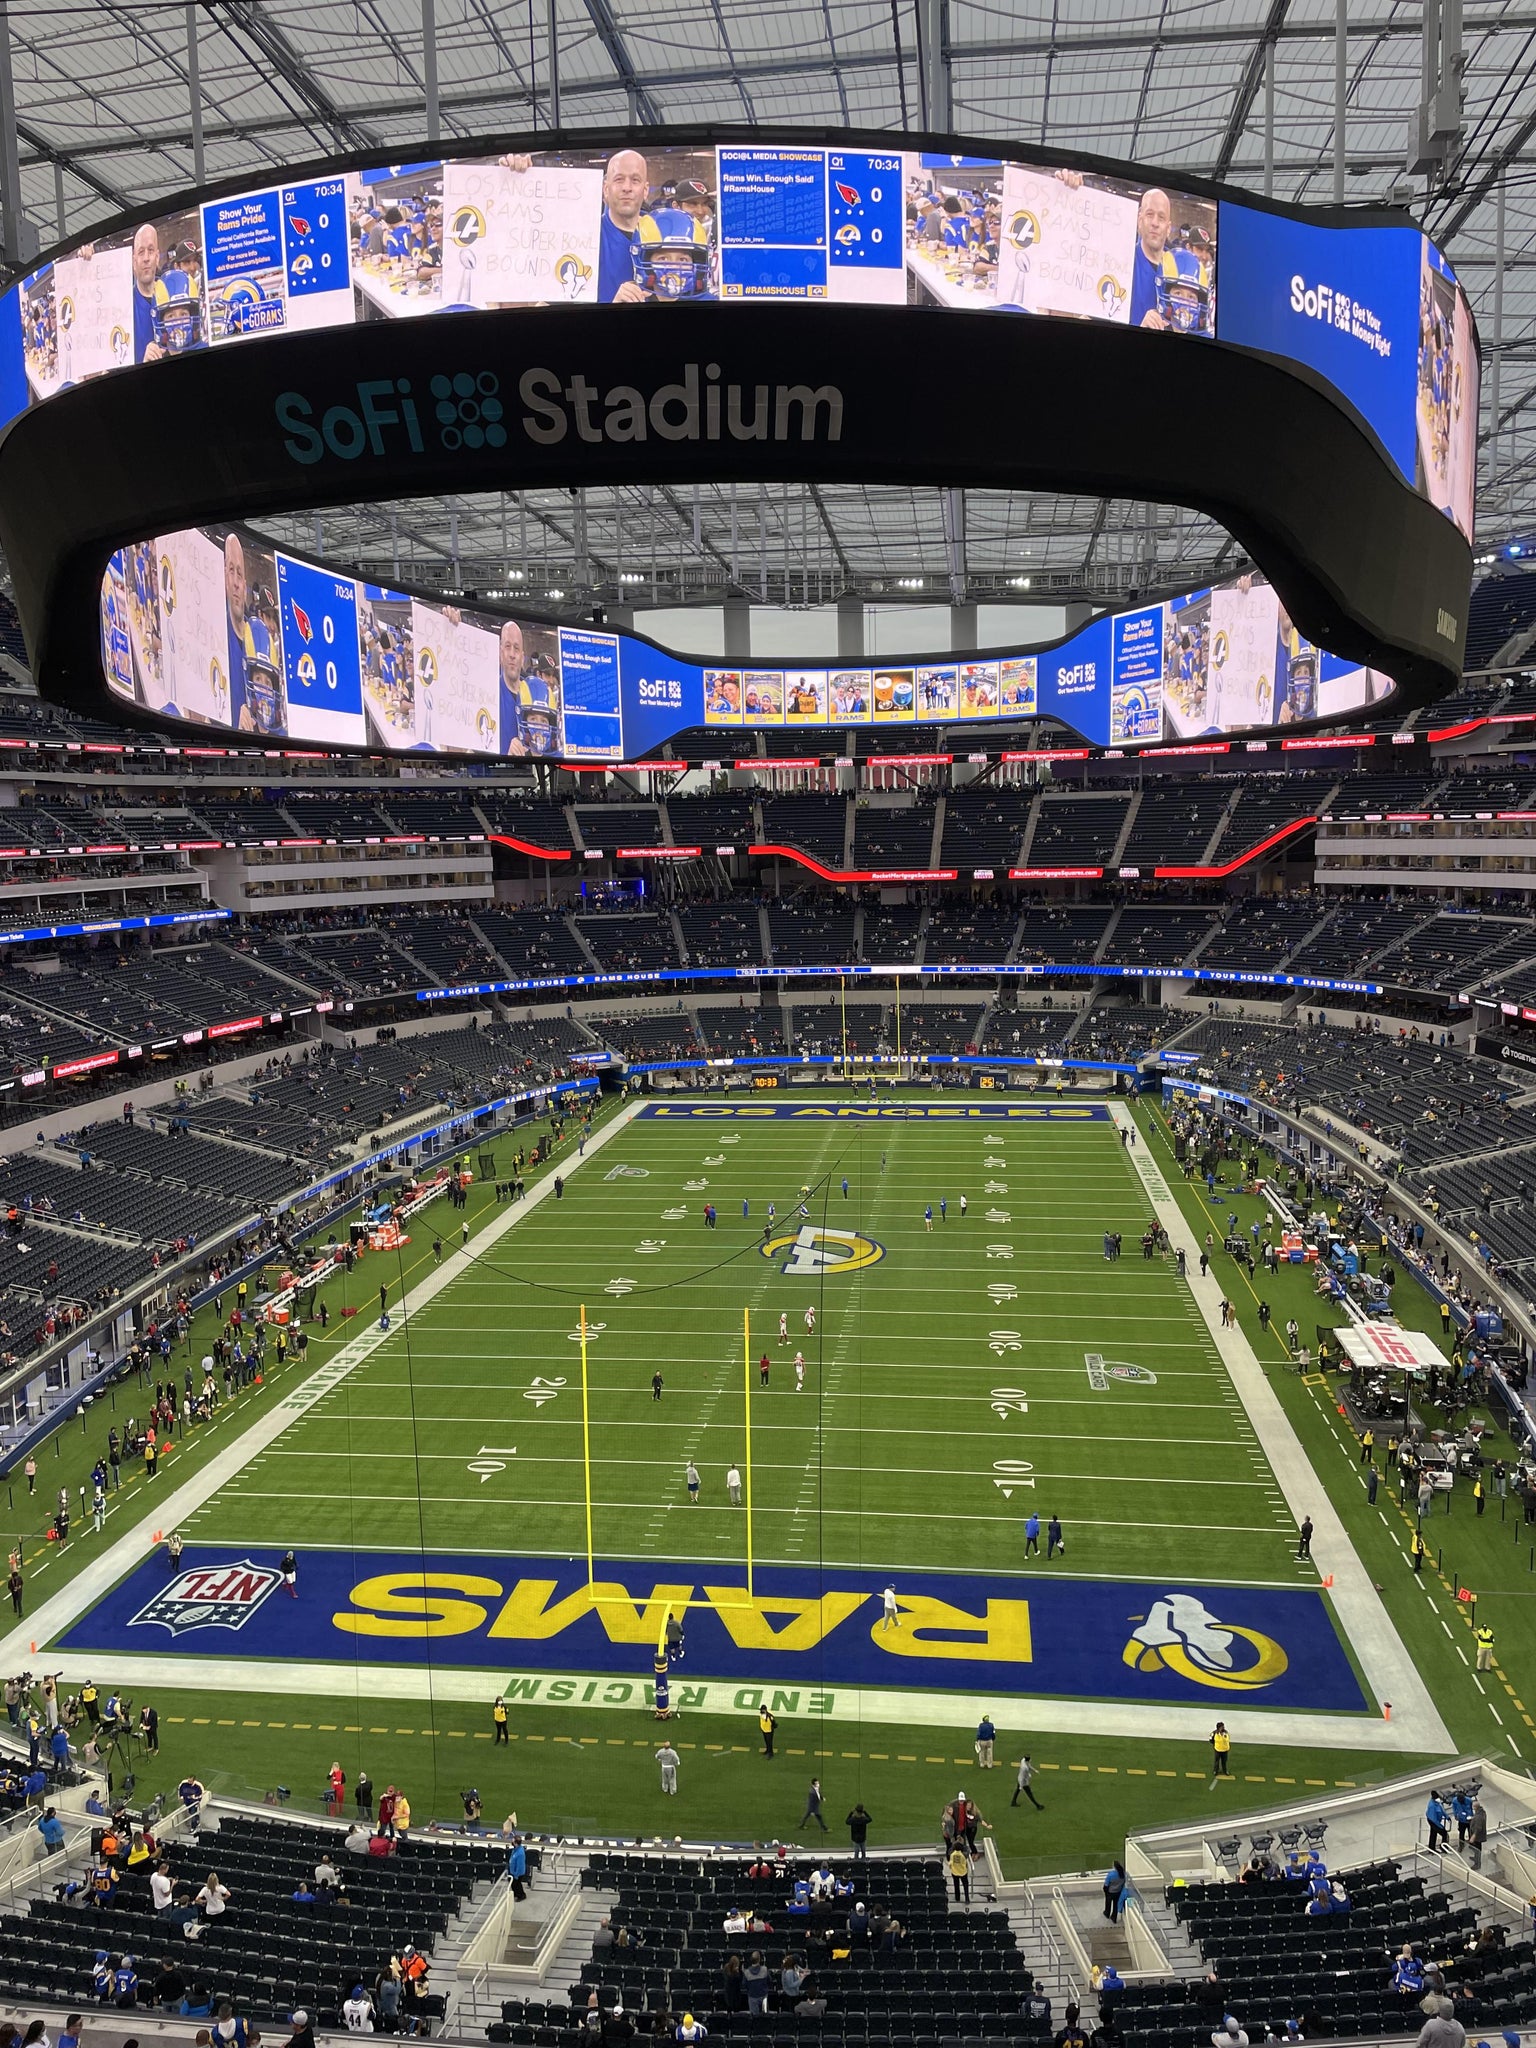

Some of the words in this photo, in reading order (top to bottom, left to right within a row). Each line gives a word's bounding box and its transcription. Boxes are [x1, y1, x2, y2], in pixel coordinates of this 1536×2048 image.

[753, 152, 778, 161] MEDIA
[778, 153, 823, 162] SHOWCASE
[831, 157, 844, 167] Q1
[868, 158, 900, 171] 70:34
[723, 174, 745, 183] Rams
[746, 174, 764, 183] Win.
[764, 174, 794, 185] Enough
[795, 175, 814, 184] Said!
[285, 193, 294, 201] Q1
[315, 184, 342, 197] 70:34
[449, 176, 491, 200] LOS
[501, 180, 584, 200] ANGELES
[723, 184, 775, 193] #RamsHouse
[871, 187, 882, 203] 0
[1008, 179, 1050, 209] LOS
[1053, 190, 1123, 226] ANGELES
[219, 209, 241, 221] Show
[243, 203, 262, 214] Your
[484, 199, 544, 223] RAMS
[218, 220, 240, 232] Rams
[242, 213, 265, 226] Pride!
[319, 214, 328, 228] 0
[1039, 208, 1091, 240] RAMS
[255, 228, 268, 236] Rams
[506, 228, 559, 250] SUPER
[871, 228, 883, 243] 0
[229, 242, 243, 251] Plates
[321, 253, 331, 267] 0
[487, 255, 550, 276] BOUND
[1039, 261, 1094, 291] BOUND
[745, 286, 806, 295] #RAMSHOUSE
[1290, 275, 1332, 324] SoFi
[1352, 302, 1366, 323] Get
[1366, 308, 1381, 332] Your
[1352, 321, 1375, 350] Money
[1375, 333, 1391, 357] Right
[274, 377, 424, 465] SoFi
[504, 363, 844, 445] Stadium
[334, 584, 354, 600] 70:34
[323, 616, 334, 644] 0
[1125, 623, 1139, 632] Show
[1140, 619, 1152, 628] Your
[1123, 632, 1138, 642] Rams
[1139, 627, 1154, 639] Pride!
[326, 661, 338, 690] 0
[1058, 665, 1083, 686] SoFi
[639, 678, 666, 698] SoFi
[1006, 705, 1031, 714] RAMS
[835, 713, 865, 722] RAMS
[1287, 736, 1370, 749] RocketMortgageSquares.com
[871, 755, 949, 765] RocketMortgageSquares.com
[1006, 750, 1085, 759] RocketMortgageSquares.com
[739, 760, 816, 768] RocketMortgageSquares.com
[621, 847, 697, 856] RocketMortgageSquares.com
[871, 870, 953, 879] RocketMortgageSquares.com
[1014, 869, 1098, 877] RocketMortgageSquares.com
[595, 974, 622, 983] RAMS
[1210, 971, 1236, 979] YOUR
[1240, 974, 1275, 982] HOUSE
[426, 990, 445, 998] OUR
[449, 986, 480, 996] HOUSE
[504, 982, 529, 990] YOUR
[533, 979, 565, 987] HOUSE
[1303, 979, 1330, 988] RAMS
[1334, 982, 1368, 992] HOUSE
[982, 1078, 993, 1087] 25
[505, 1094, 527, 1104] RAMS
[530, 1086, 557, 1098] HOUSE
[654, 1108, 777, 1117] LOS
[790, 1109, 1093, 1118] ANGELES
[436, 1123, 452, 1133] YOUR
[454, 1112, 474, 1125] HOUSE
[366, 1156, 381, 1167] OUR
[383, 1144, 405, 1158] HOUSE
[984, 1158, 1006, 1168] 20
[683, 1178, 710, 1191] 30
[984, 1183, 1008, 1193] 30
[660, 1208, 688, 1220] 40
[985, 1211, 1011, 1223] 40
[634, 1240, 667, 1253] 50
[986, 1245, 1014, 1258] 50
[604, 1278, 638, 1293] 40
[987, 1284, 1018, 1299] 40
[568, 1323, 607, 1340] 30
[988, 1331, 1022, 1350] 30
[280, 1358, 357, 1409] CHANGE
[523, 1376, 567, 1399] 20
[990, 1388, 1028, 1412] 20
[467, 1446, 517, 1473] 10
[992, 1460, 1035, 1488] 10
[177, 1568, 271, 1603] NFL
[332, 1572, 1033, 1663] RAMS
[733, 1688, 835, 1714] END
[776, 1870, 784, 1878] 21
[121, 1980, 126, 1992] 9
[349, 2015, 361, 2027] 44
